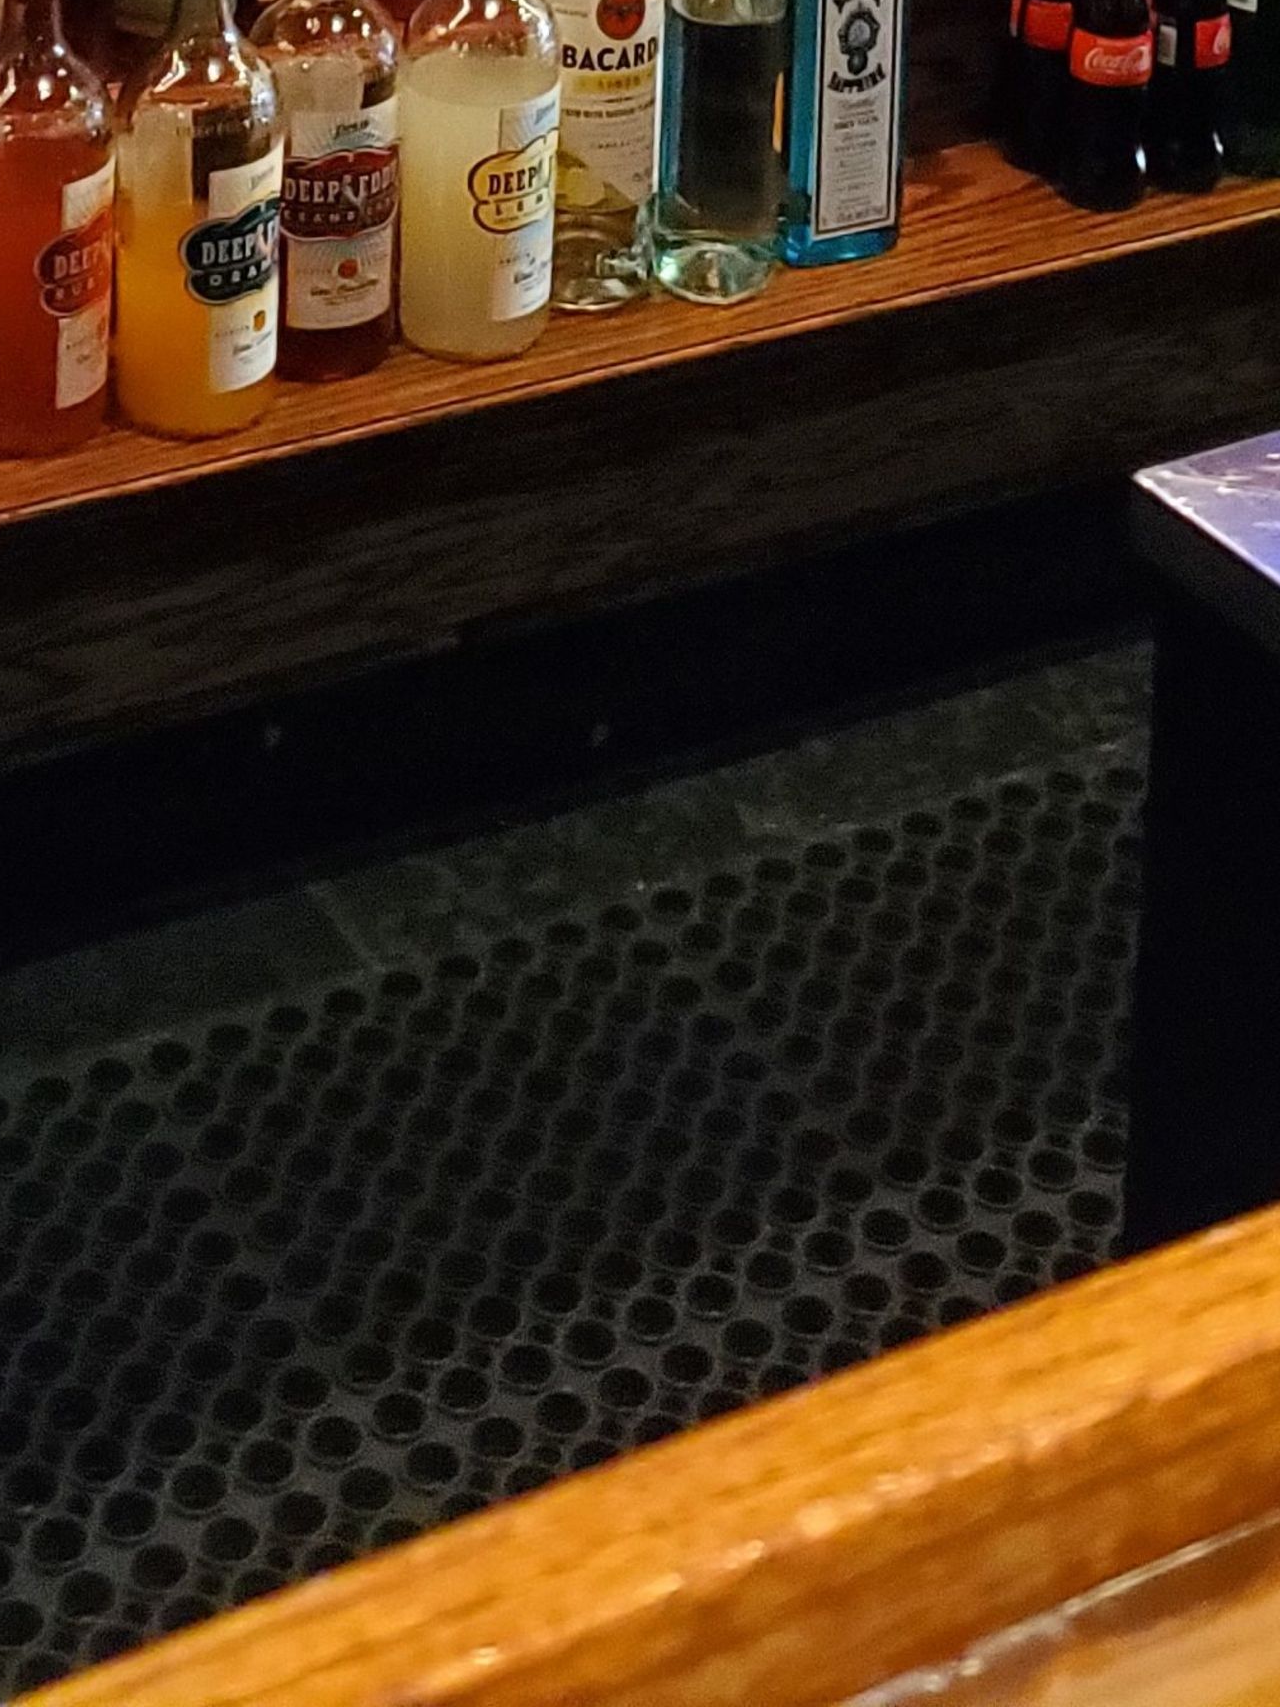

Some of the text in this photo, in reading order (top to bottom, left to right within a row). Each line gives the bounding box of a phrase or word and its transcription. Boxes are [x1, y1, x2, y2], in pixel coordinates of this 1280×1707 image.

[283, 175, 345, 206] DEEP
[487, 166, 538, 196] DEEP
[200, 230, 258, 266] DEEP
